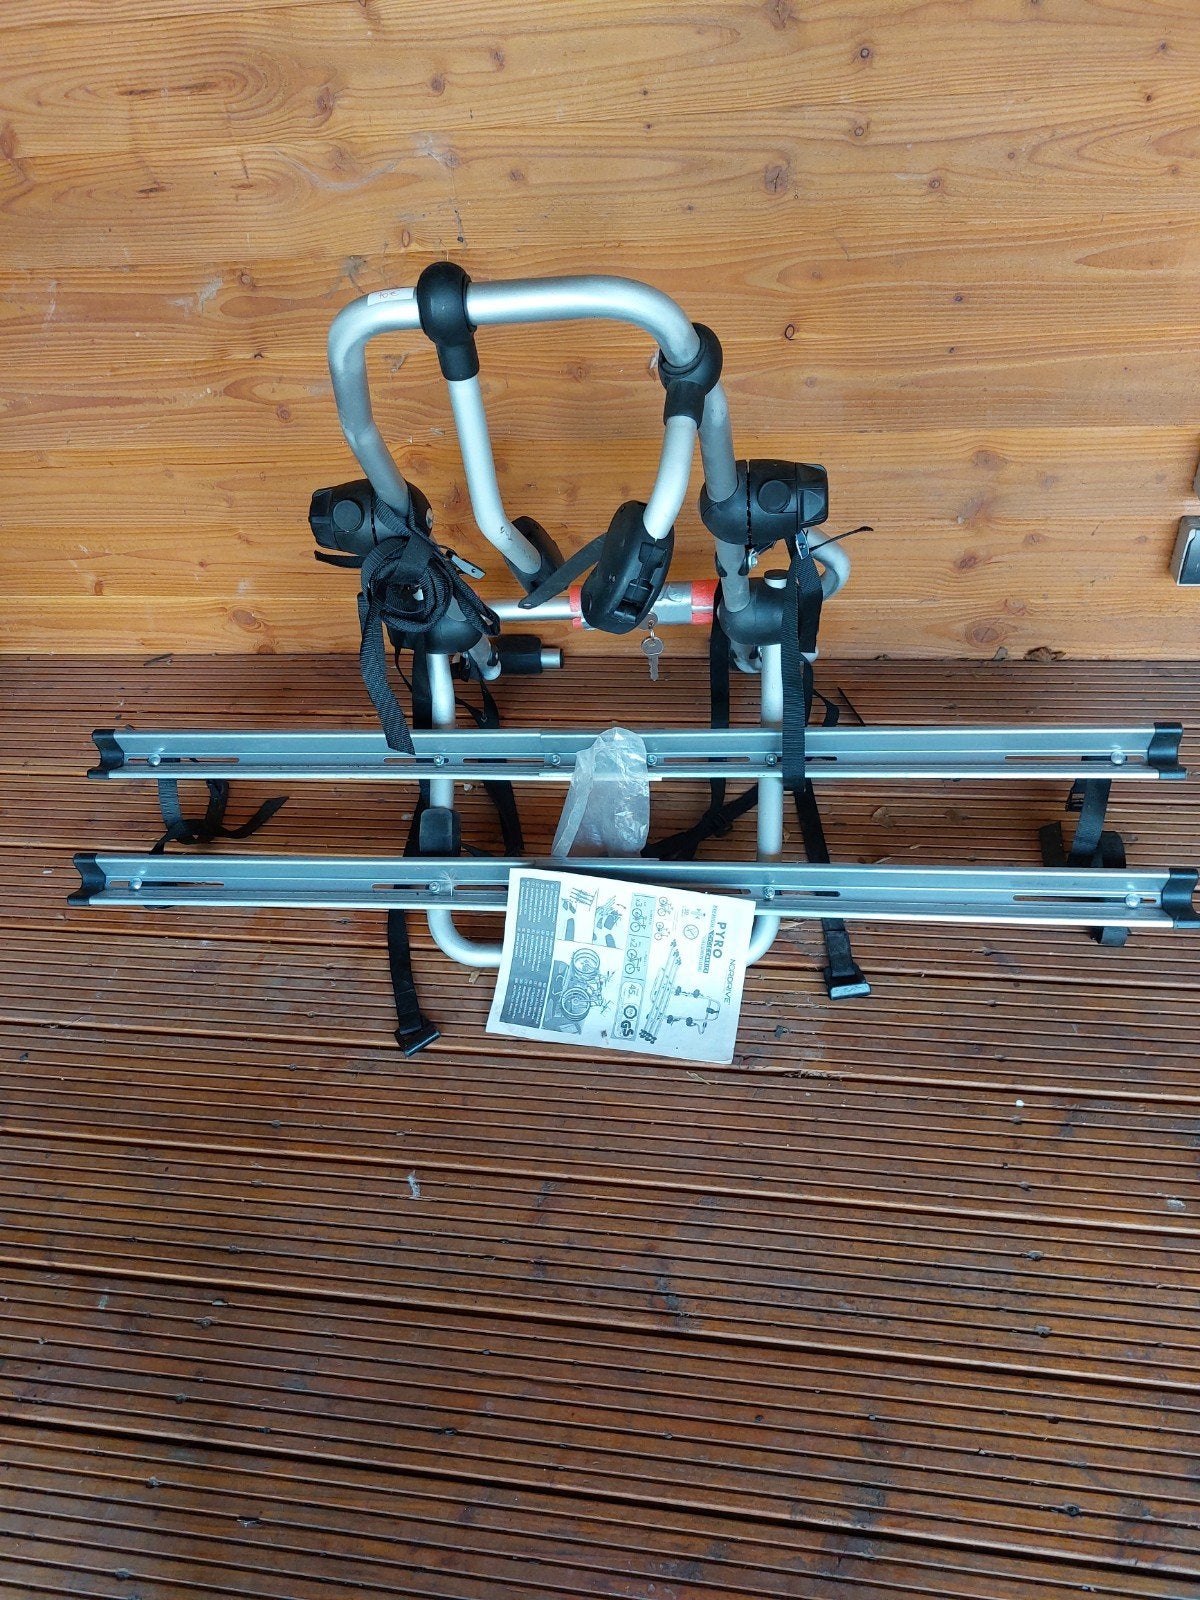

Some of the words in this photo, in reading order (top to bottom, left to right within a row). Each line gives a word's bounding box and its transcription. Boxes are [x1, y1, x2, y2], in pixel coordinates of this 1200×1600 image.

[712, 921, 727, 959] PYRO
[628, 984, 636, 995] 45
[724, 958, 736, 1003] NORDRIVE
[620, 1020, 634, 1037] GS
